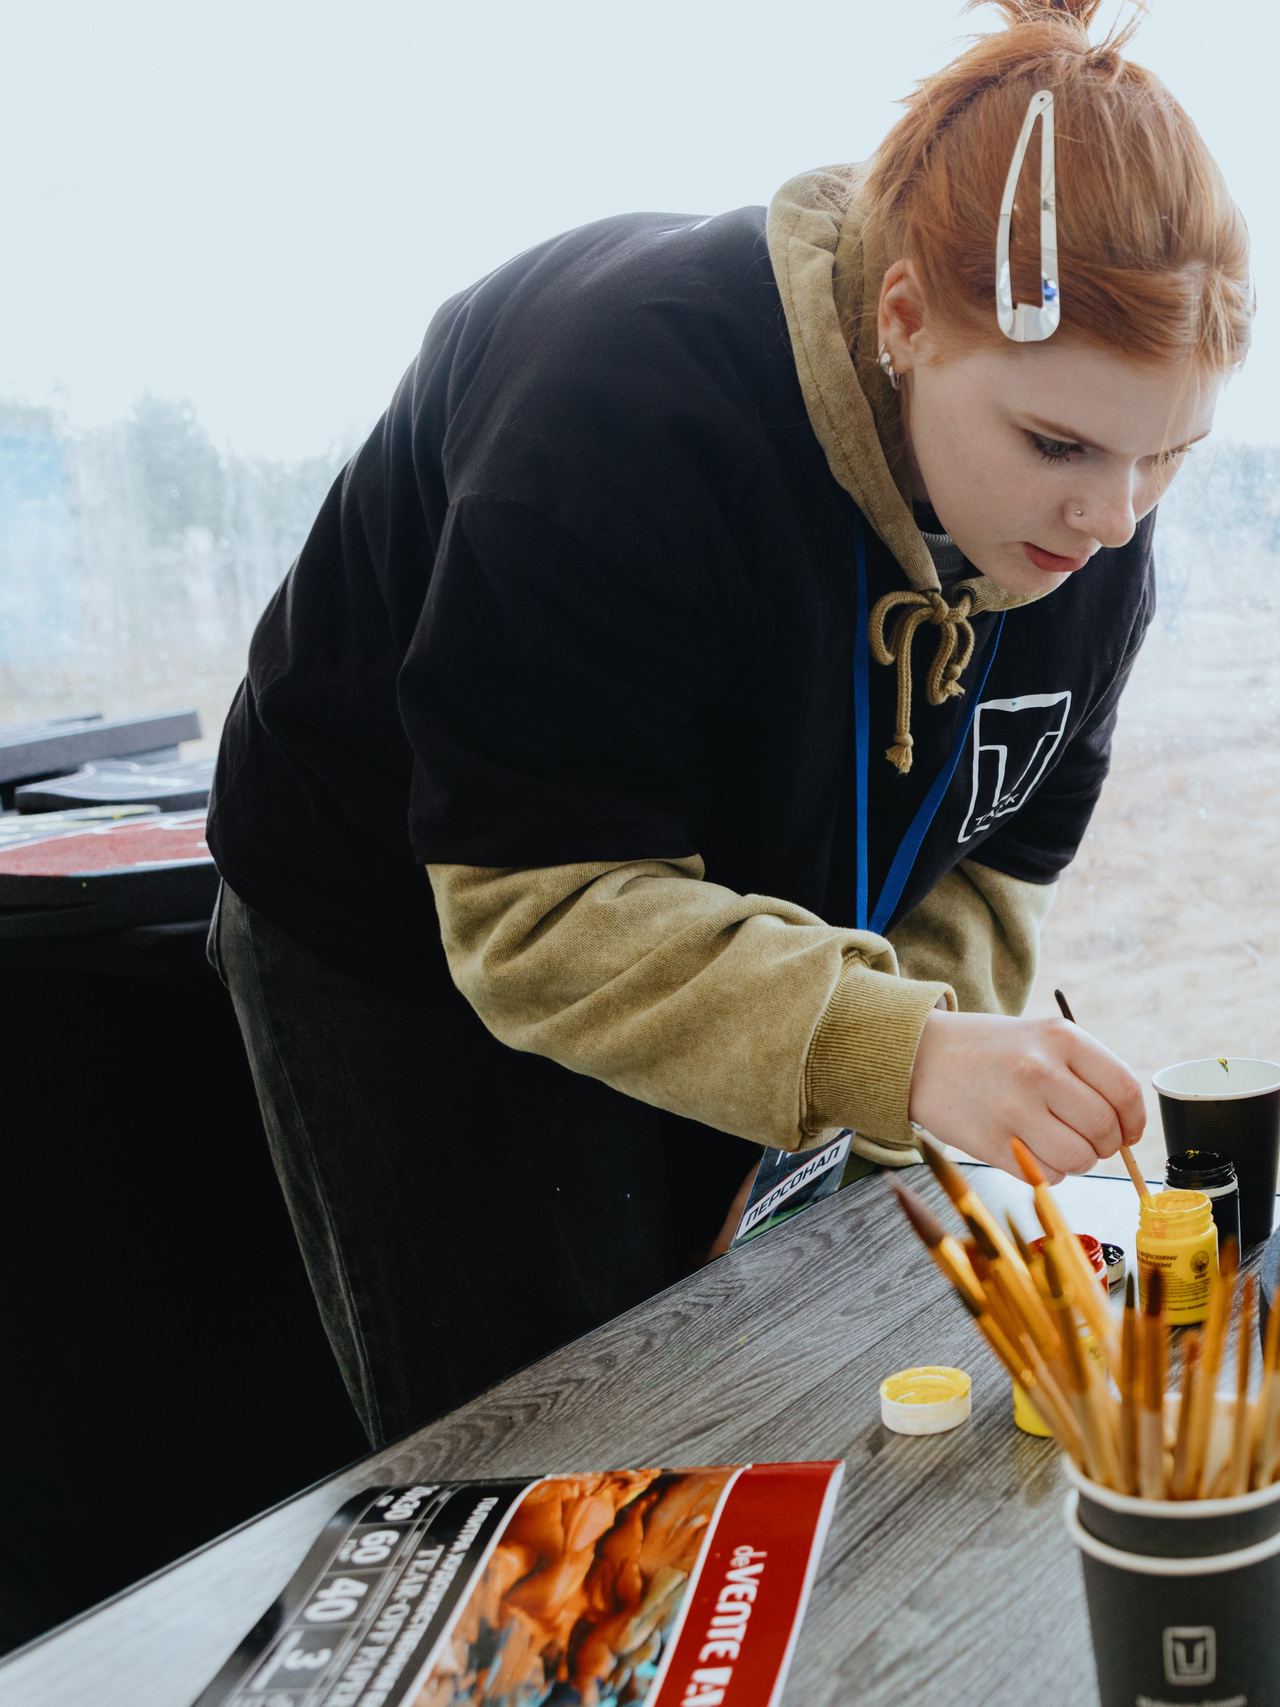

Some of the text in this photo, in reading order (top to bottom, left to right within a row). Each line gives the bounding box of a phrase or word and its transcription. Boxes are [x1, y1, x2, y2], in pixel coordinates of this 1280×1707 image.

[745, 1145, 841, 1227] ПЕРСОНАЛ
[351, 1529, 400, 1564] 60
[303, 1577, 369, 1623] 40
